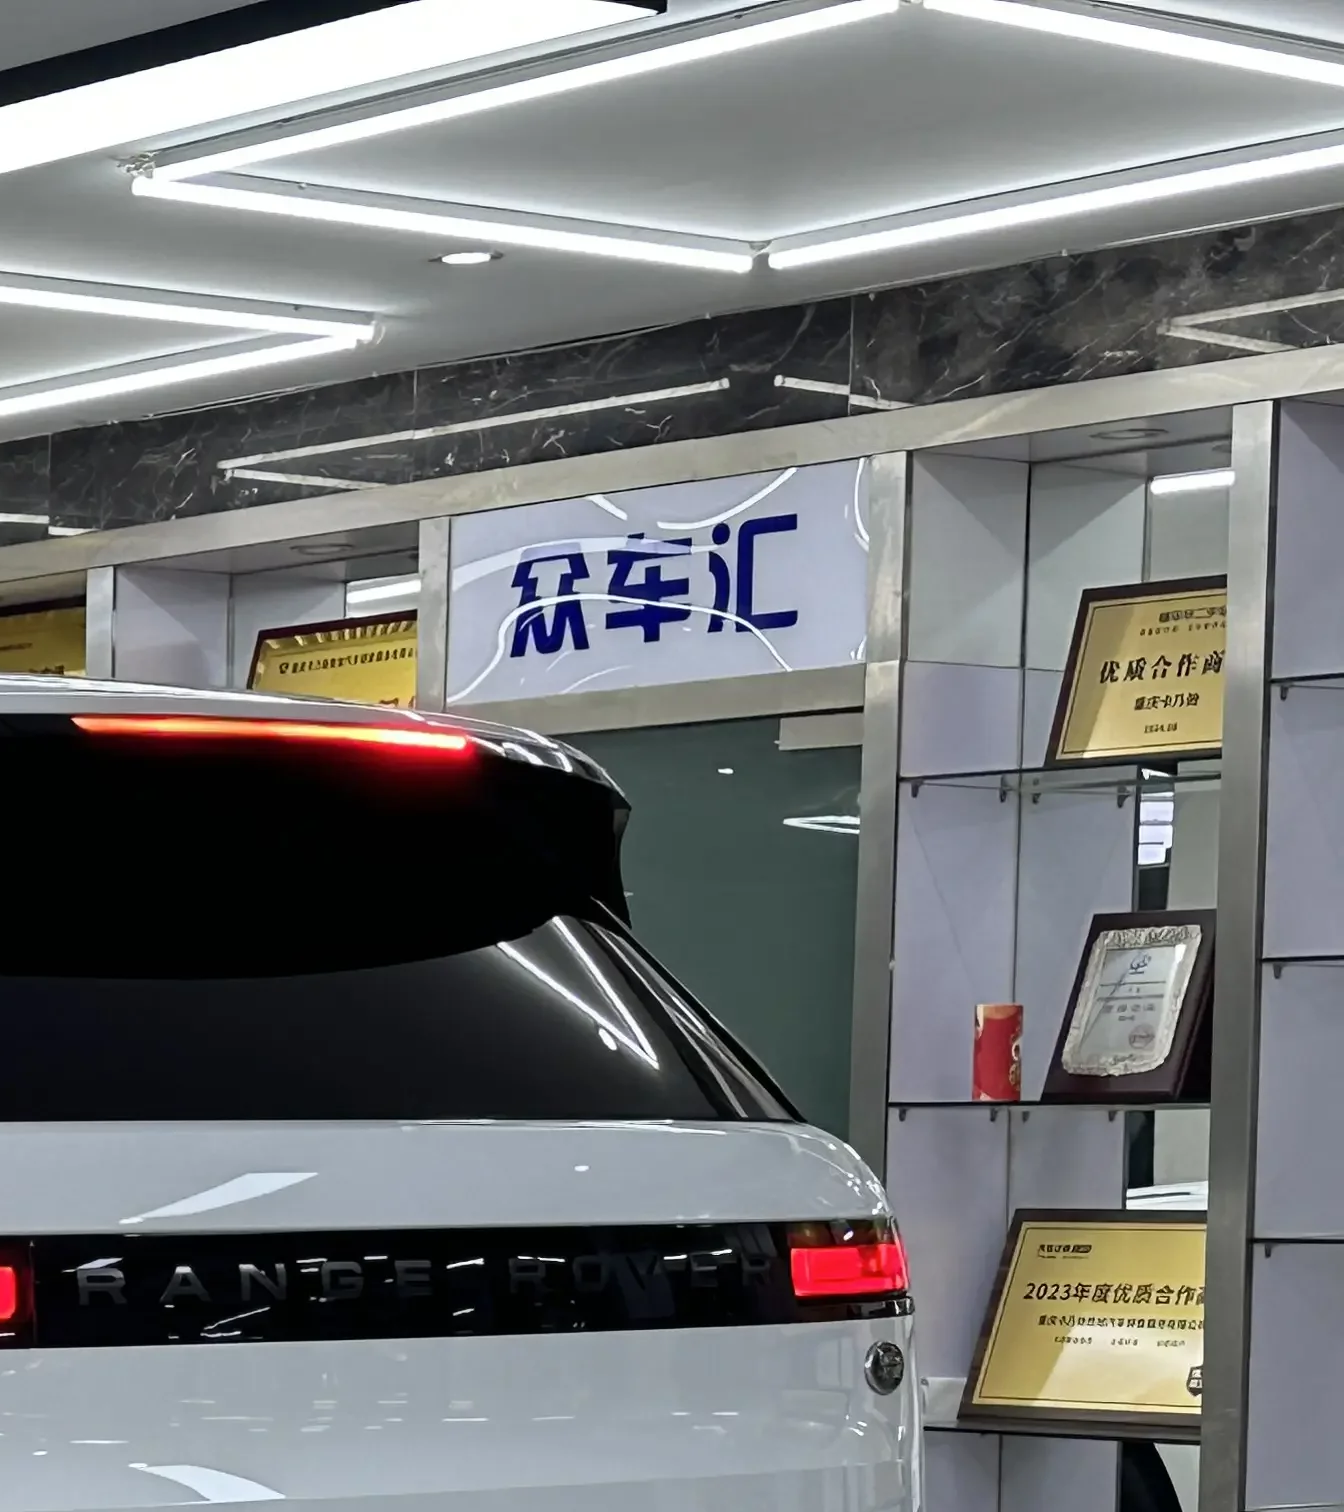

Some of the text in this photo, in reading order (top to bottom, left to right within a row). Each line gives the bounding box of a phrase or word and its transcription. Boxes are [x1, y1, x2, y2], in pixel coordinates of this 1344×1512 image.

[510, 513, 798, 658] 众车汇
[77, 1252, 772, 1304] RANGE ROVER
